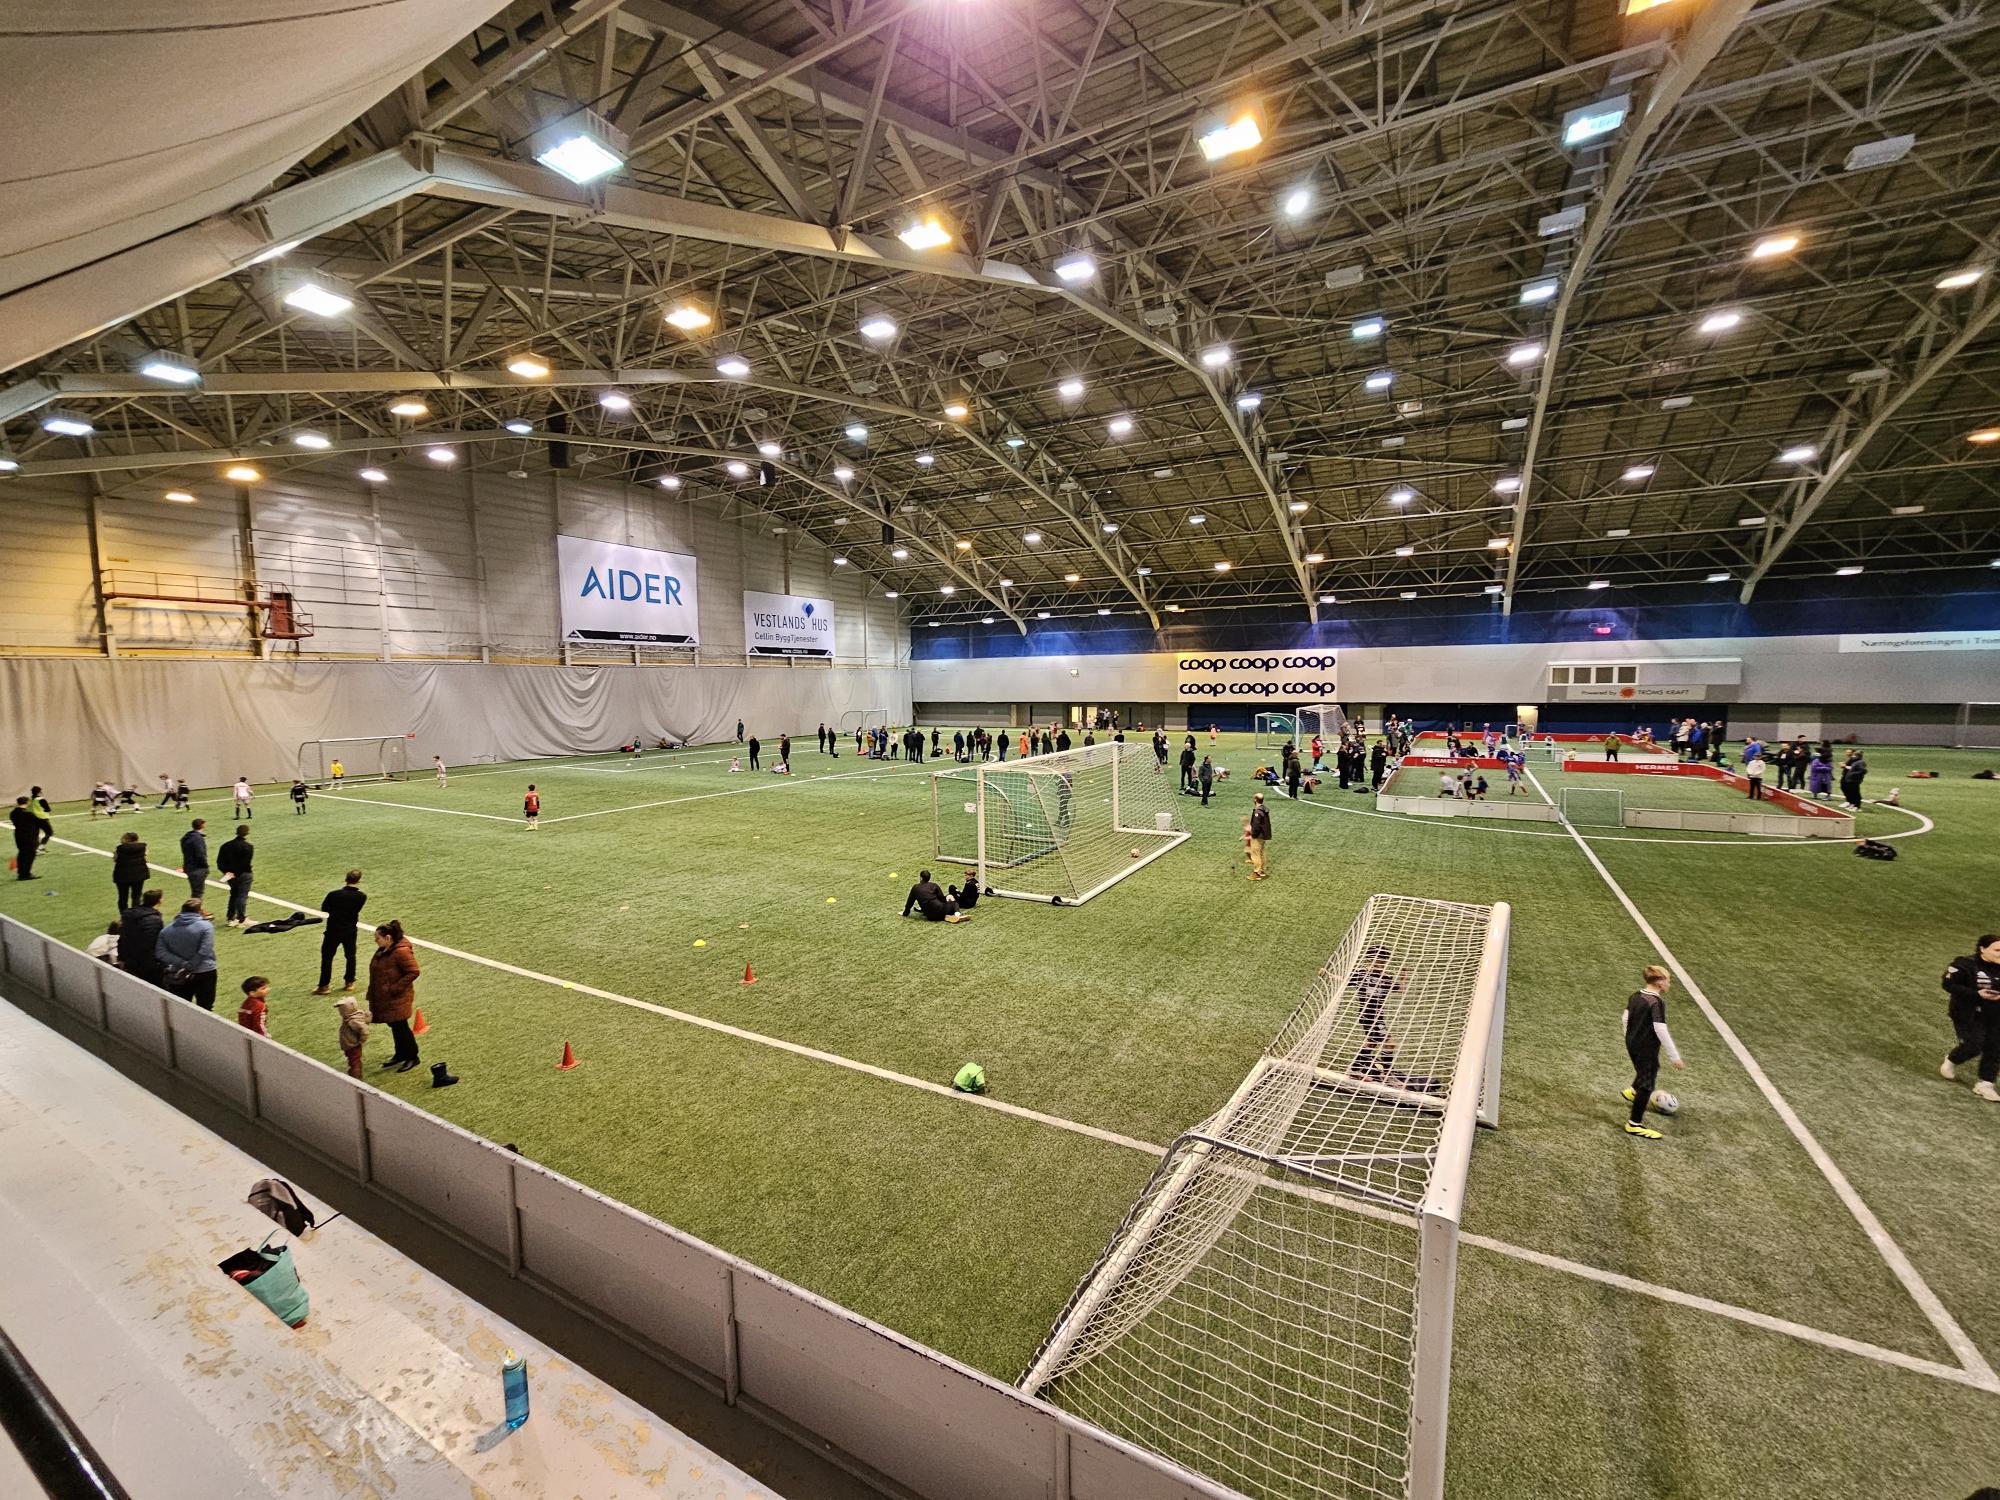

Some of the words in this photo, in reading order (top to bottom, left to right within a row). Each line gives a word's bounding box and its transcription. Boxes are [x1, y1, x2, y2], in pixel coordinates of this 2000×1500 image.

[580, 566, 683, 606] AIDER
[753, 613, 805, 629] VESTLANDS
[812, 618, 828, 631] HUS
[754, 632, 774, 640] Cellin
[1179, 659, 1226, 672] coop
[1229, 658, 1279, 671] coop
[1282, 656, 1336, 671] coop
[1179, 683, 1226, 697] coop
[1229, 682, 1279, 697] coop
[1282, 682, 1336, 697] coop
[1609, 690, 1617, 698] by
